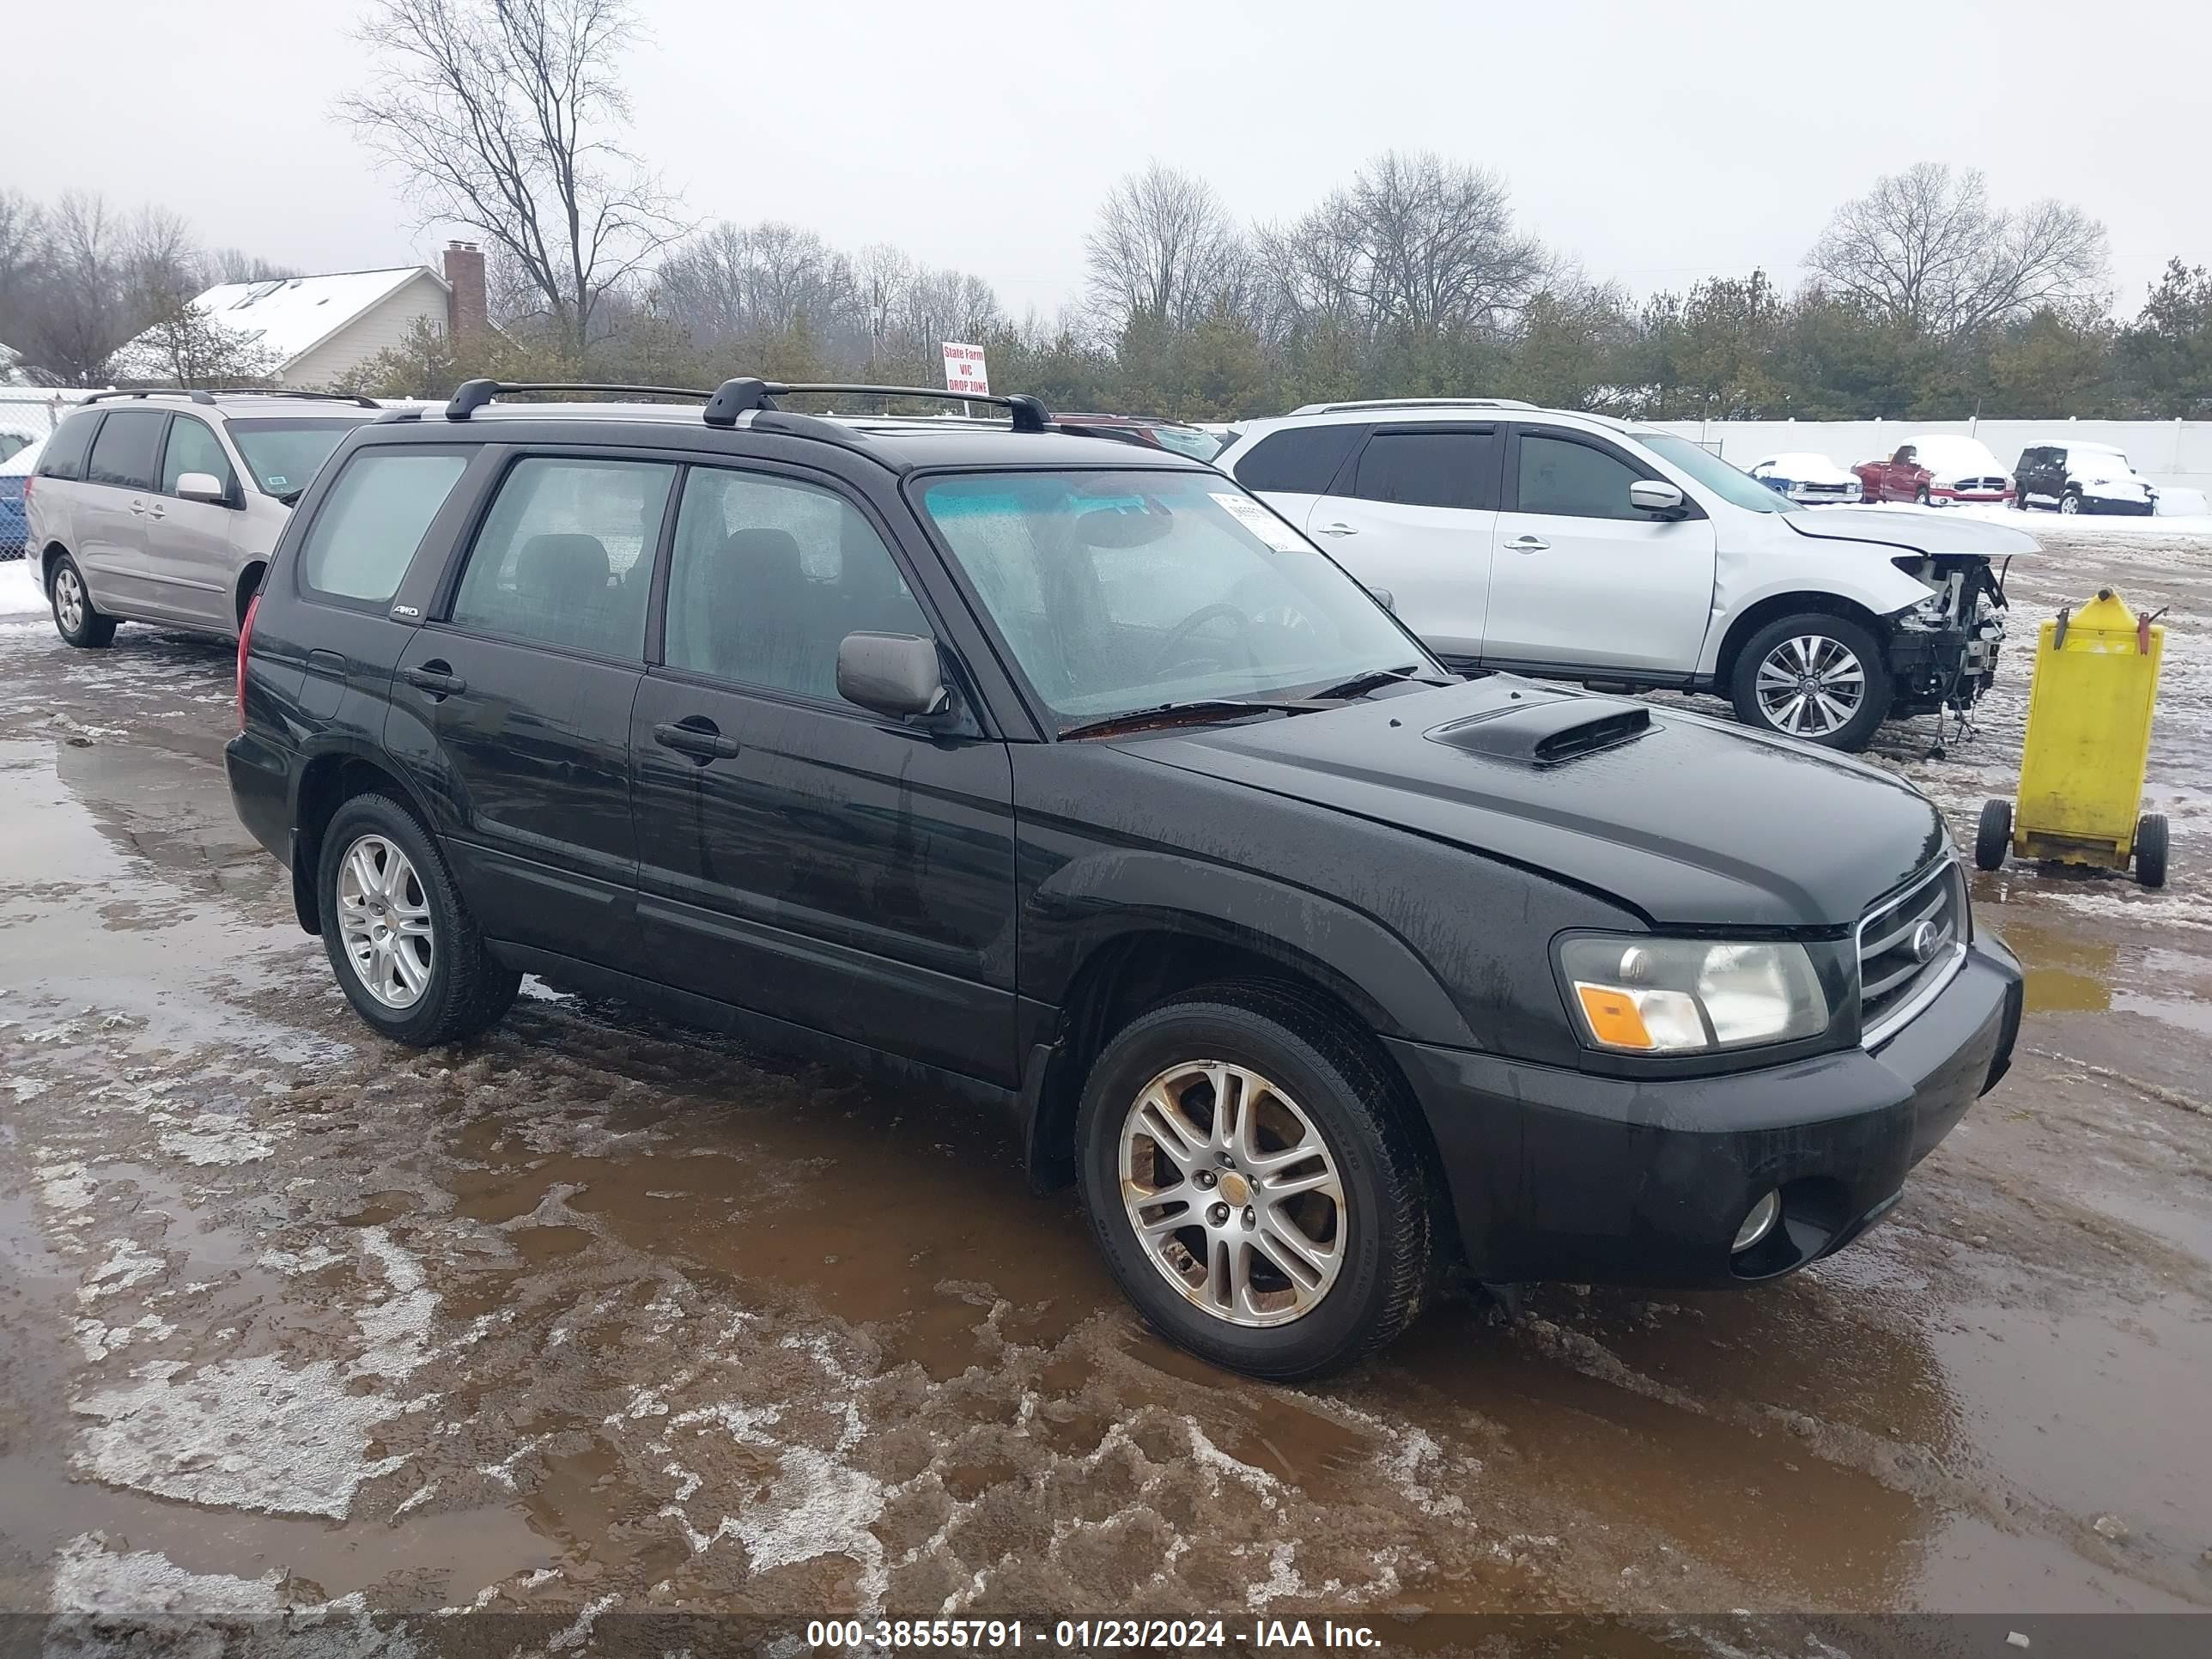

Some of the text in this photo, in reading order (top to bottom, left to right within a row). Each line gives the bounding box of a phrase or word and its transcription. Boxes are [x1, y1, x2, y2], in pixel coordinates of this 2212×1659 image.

[945, 346, 984, 361] State Farm
[959, 363, 973, 376] VIC
[949, 379, 988, 393] DROP ZONE
[392, 605, 419, 616] AWD
